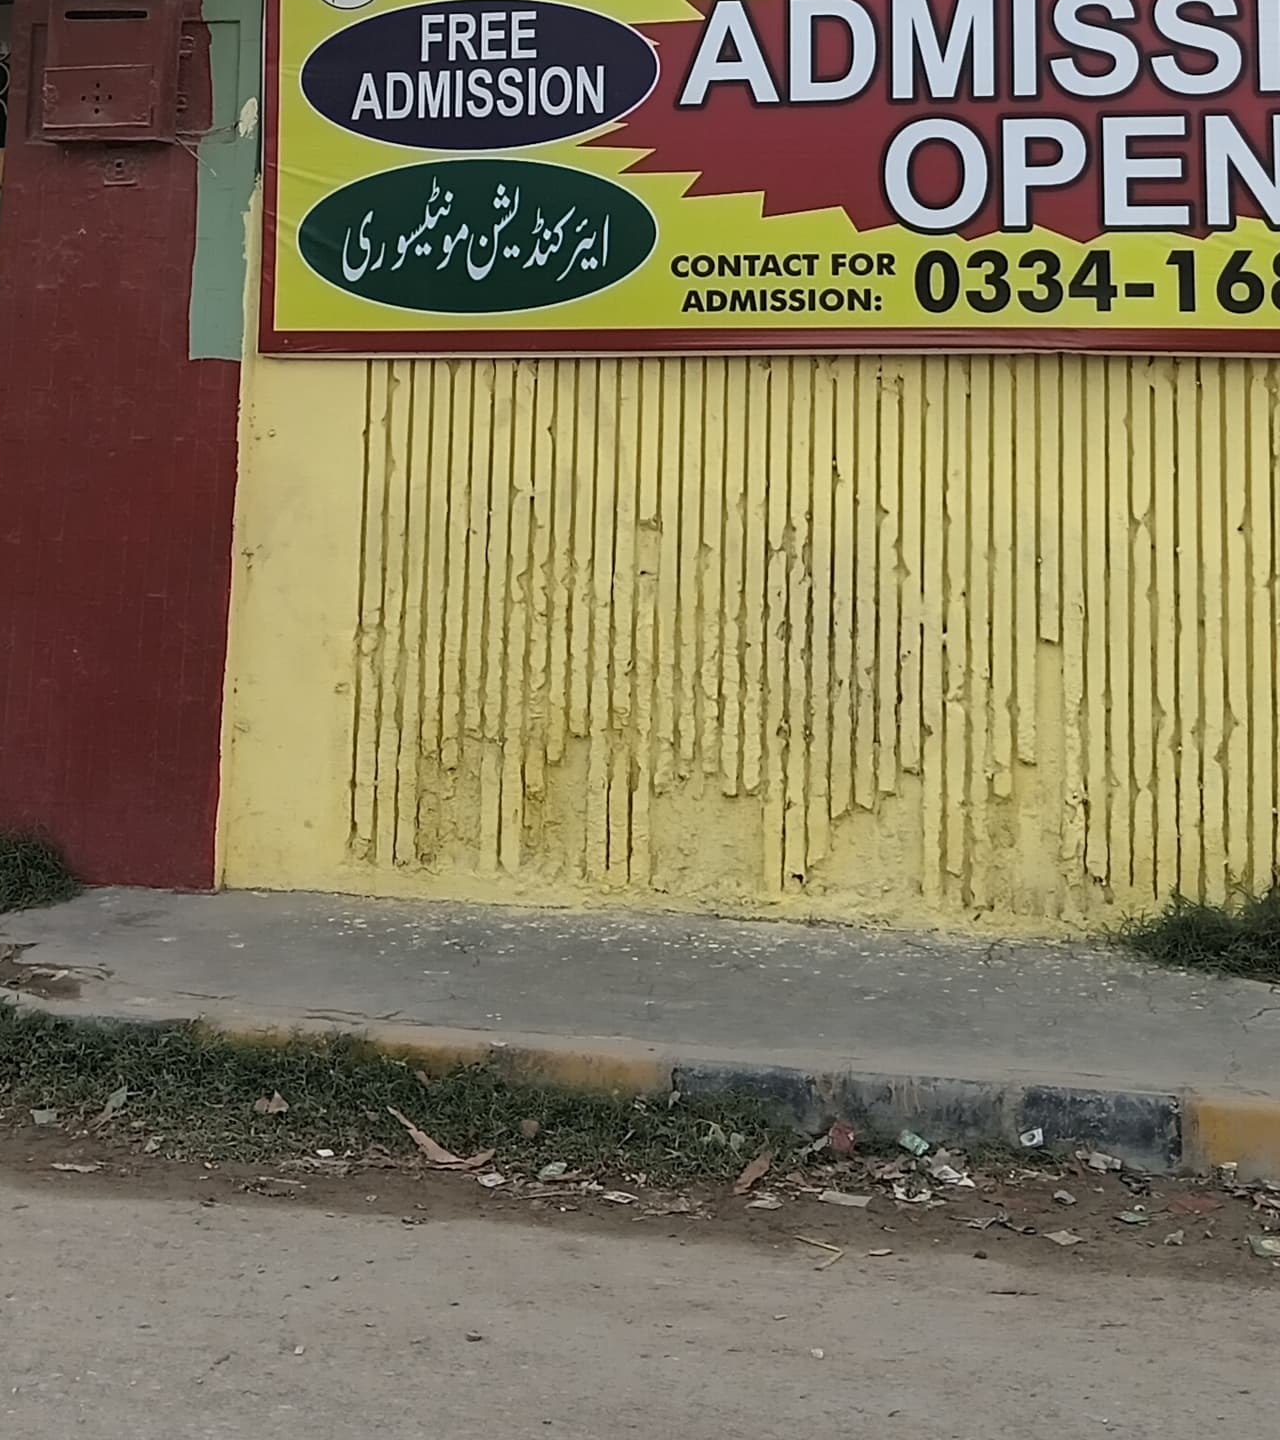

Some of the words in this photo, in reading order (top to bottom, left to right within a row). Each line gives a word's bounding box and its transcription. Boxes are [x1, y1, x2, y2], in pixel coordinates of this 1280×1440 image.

[420, 10, 538, 62] FREE
[351, 65, 605, 120] ADMISSION
[670, 254, 821, 279] CONTACT
[830, 252, 896, 276] FOR
[682, 288, 884, 314] ADMISSION:
